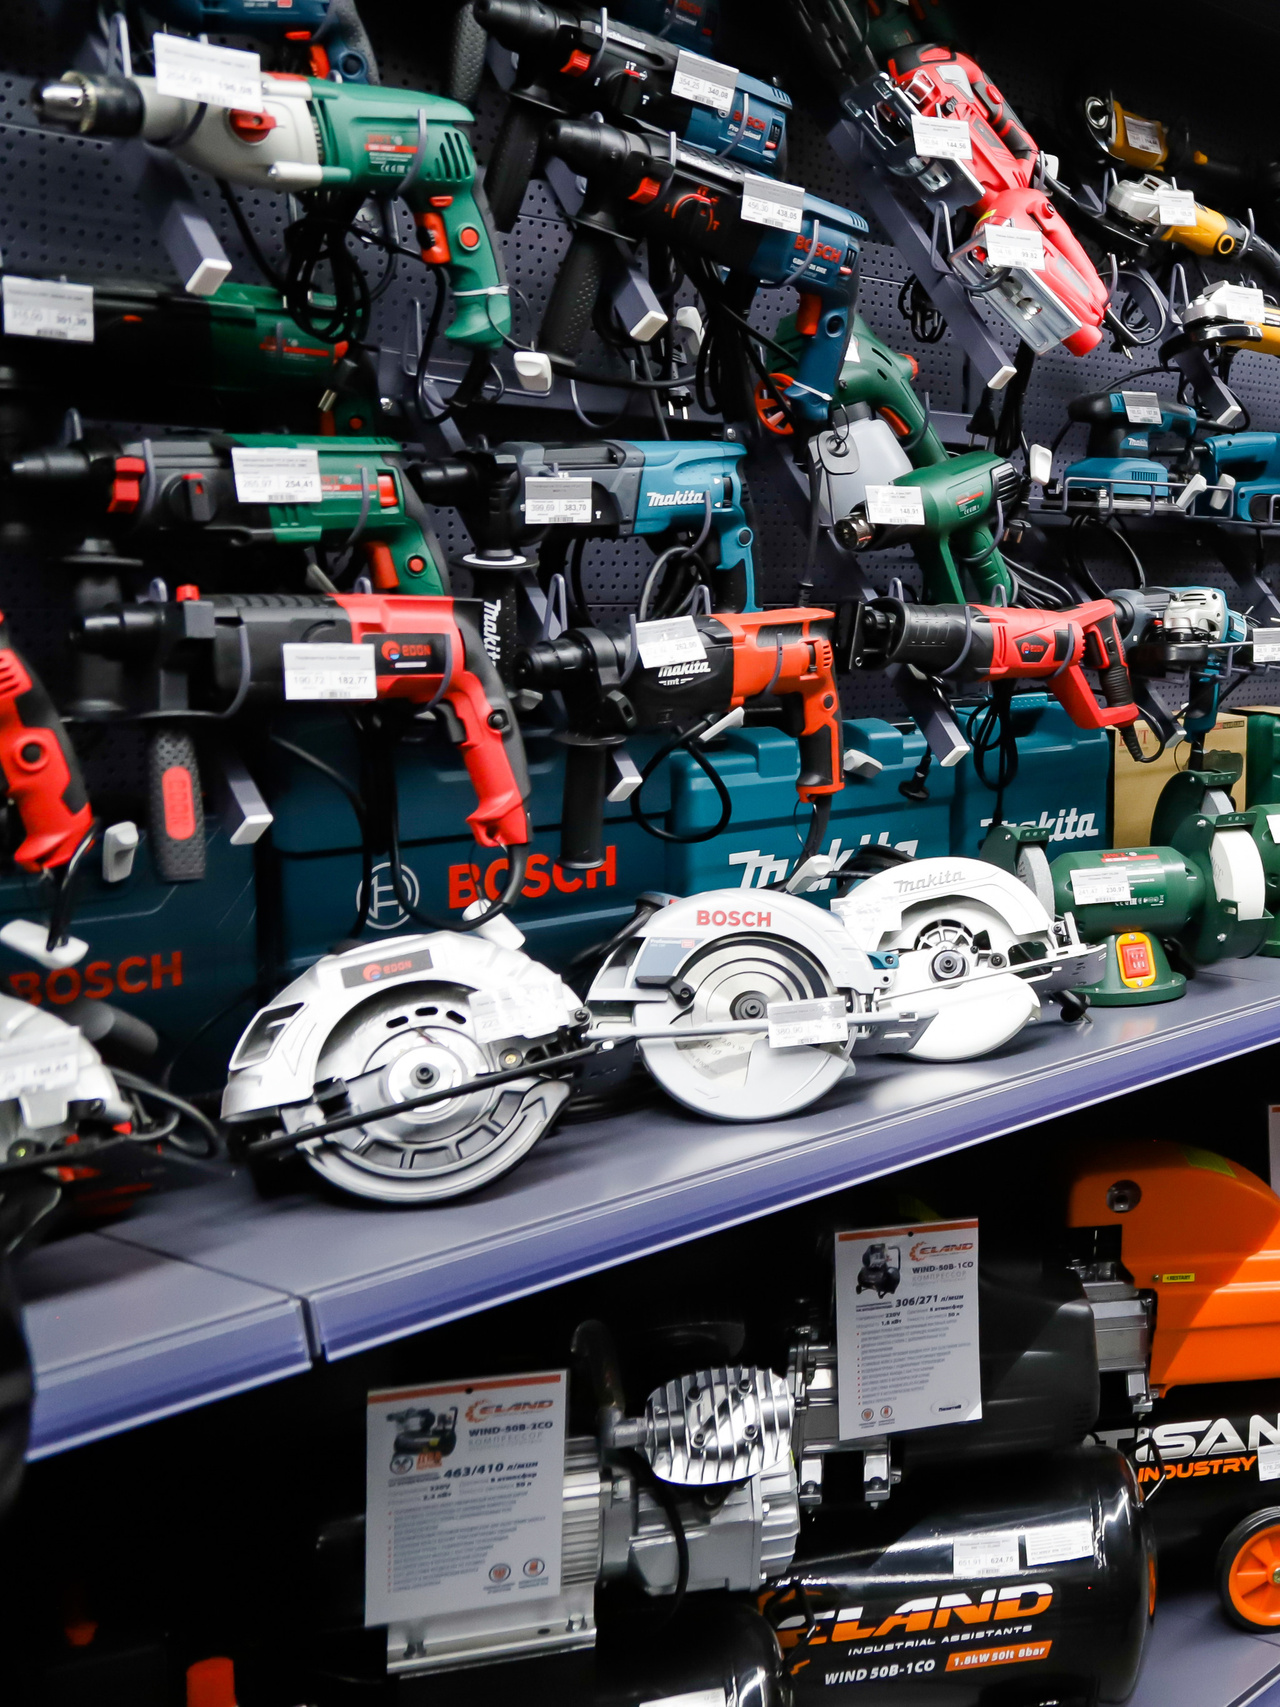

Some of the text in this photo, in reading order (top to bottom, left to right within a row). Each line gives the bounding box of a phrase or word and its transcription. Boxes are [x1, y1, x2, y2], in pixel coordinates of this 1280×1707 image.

[733, 110, 766, 131] BSCH
[448, 845, 617, 909] BOSCH
[696, 910, 771, 927] BOSCH
[9, 951, 183, 1007] BOSCH
[912, 1261, 974, 1275] WIND-50B-1CO
[895, 1295, 938, 1308] 306/271
[444, 1463, 504, 1480] 463/410
[1138, 1455, 1258, 1483] INDUSTRY
[848, 1625, 1032, 1656] INDUSTRIAL ASSISTANTS
[1017, 1646, 1046, 1659] 8bar
[824, 1659, 936, 1685] WIND 50B-1CO
